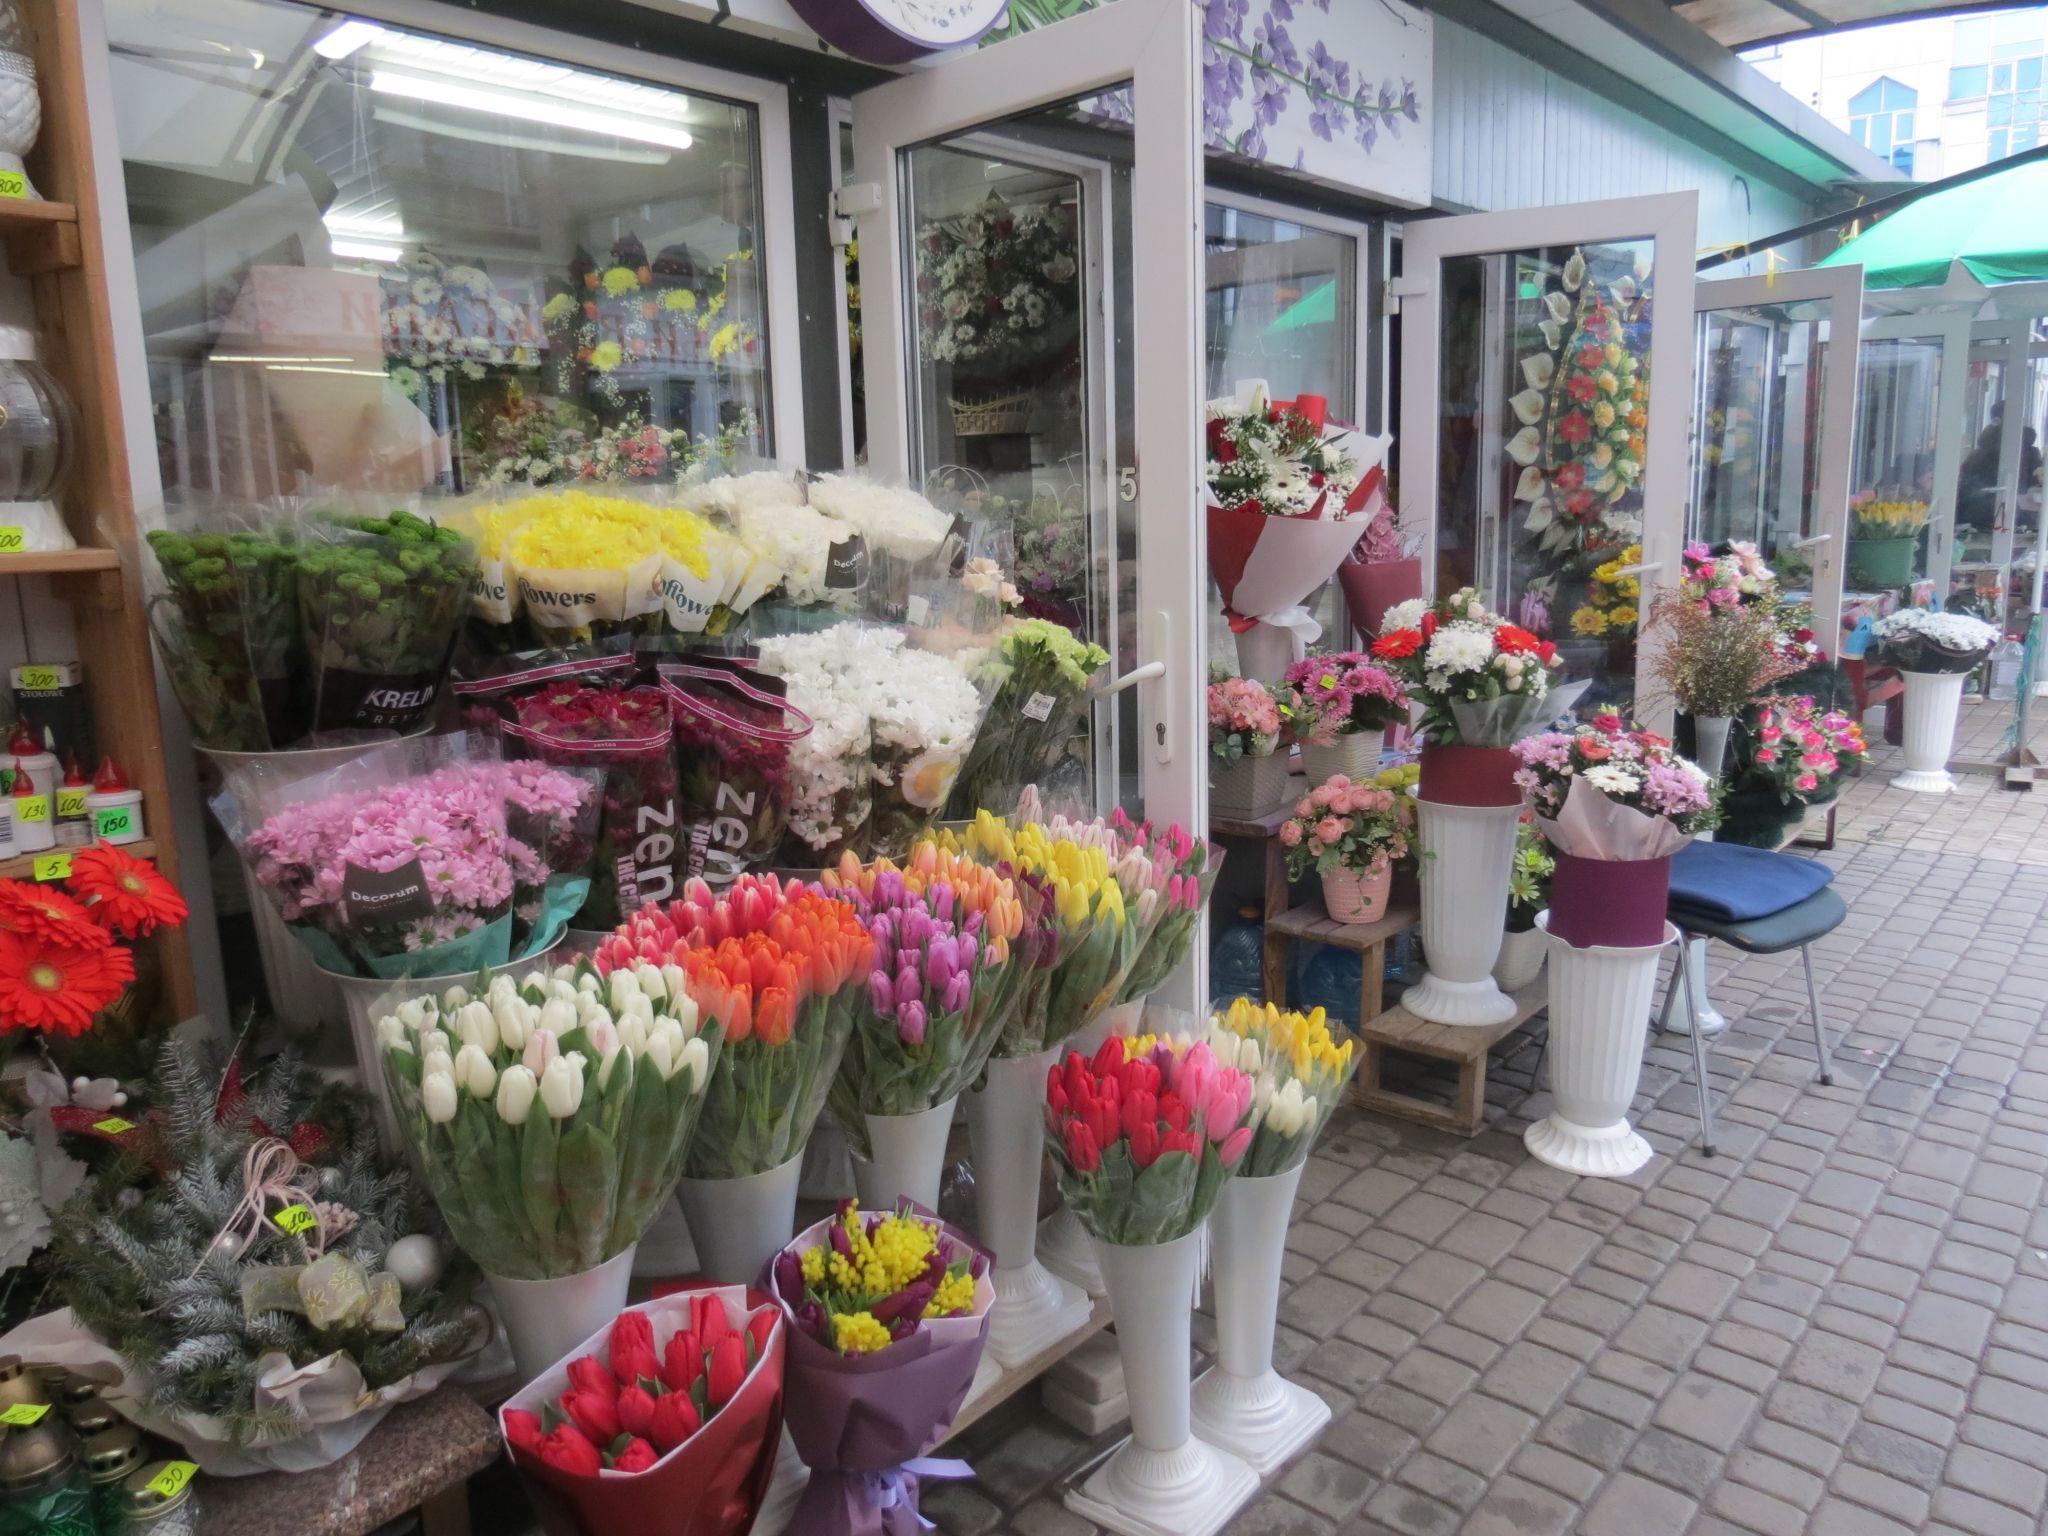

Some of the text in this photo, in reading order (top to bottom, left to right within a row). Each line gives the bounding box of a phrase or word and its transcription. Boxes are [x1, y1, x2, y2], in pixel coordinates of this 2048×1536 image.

[1120, 466, 1137, 502] 5
[23, 804, 46, 819] 130
[102, 815, 128, 835] 150
[690, 823, 713, 855] THE
[702, 781, 756, 884] zen
[635, 798, 675, 905] zen
[46, 861, 61, 877] 5
[617, 852, 638, 884] THE
[351, 884, 419, 903] Decorum
[160, 1467, 183, 1492] 30
